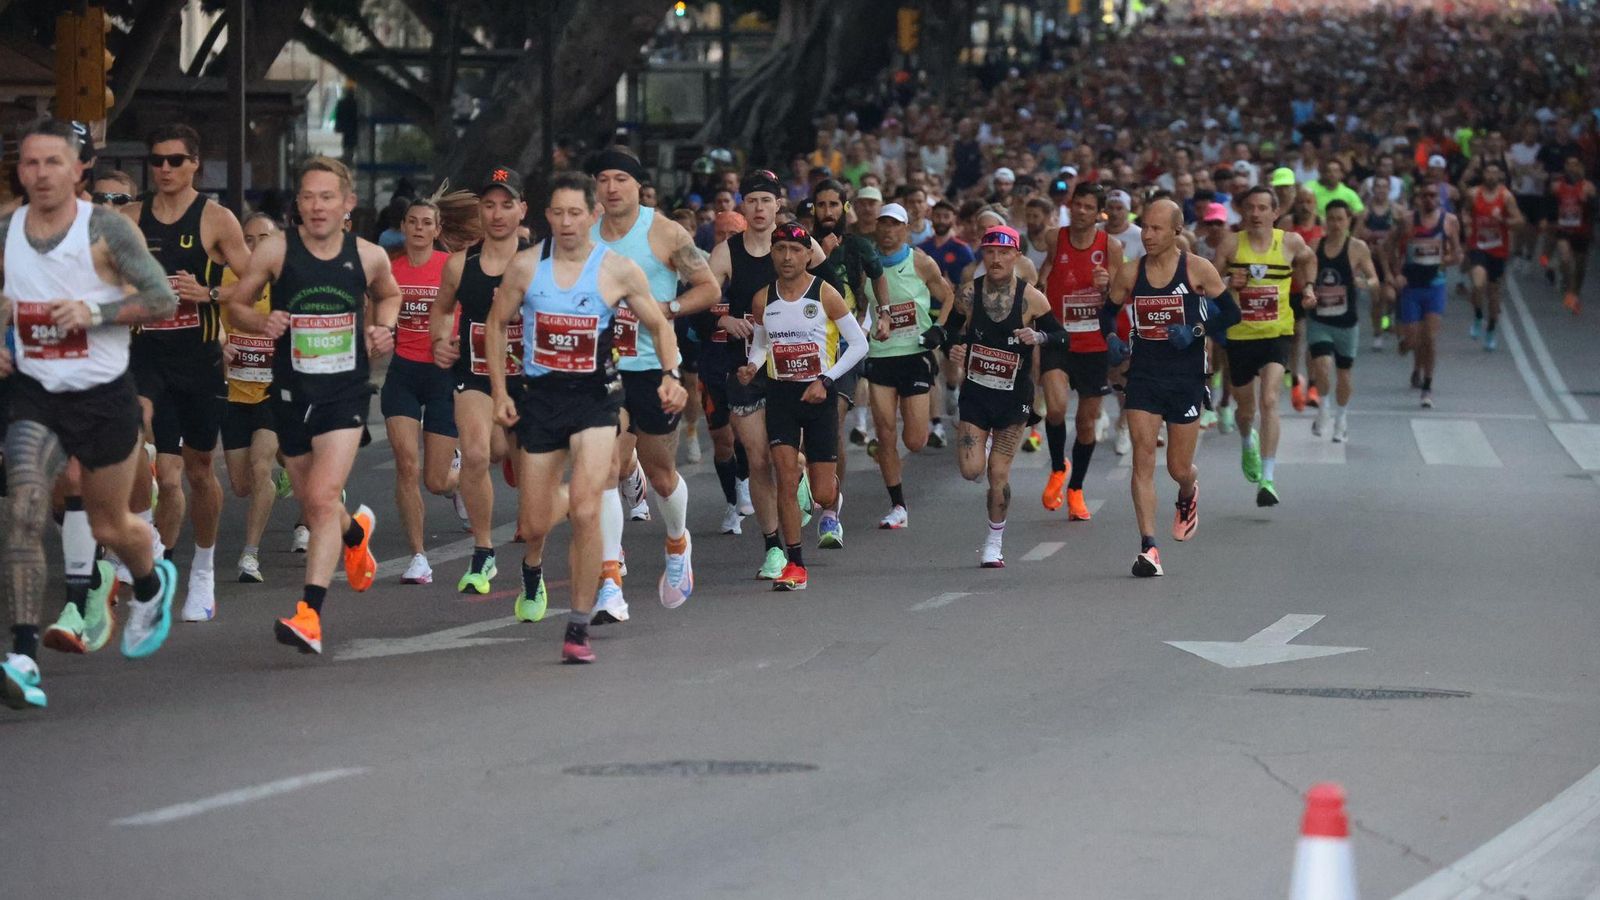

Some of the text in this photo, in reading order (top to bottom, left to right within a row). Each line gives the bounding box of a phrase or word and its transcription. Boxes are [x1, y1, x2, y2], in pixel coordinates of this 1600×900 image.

[405, 302, 428, 312] 1646
[310, 315, 352, 327] GENERALI
[550, 316, 593, 327] GENERALI
[1147, 311, 1171, 321] 6256
[241, 339, 273, 347] GENERALI
[548, 333, 579, 347] 3921
[784, 344, 816, 353] GENERALI
[238, 352, 266, 363] 15964
[983, 349, 1016, 361] GENERALI
[785, 358, 809, 369] 1054
[979, 360, 1007, 373] 10449
